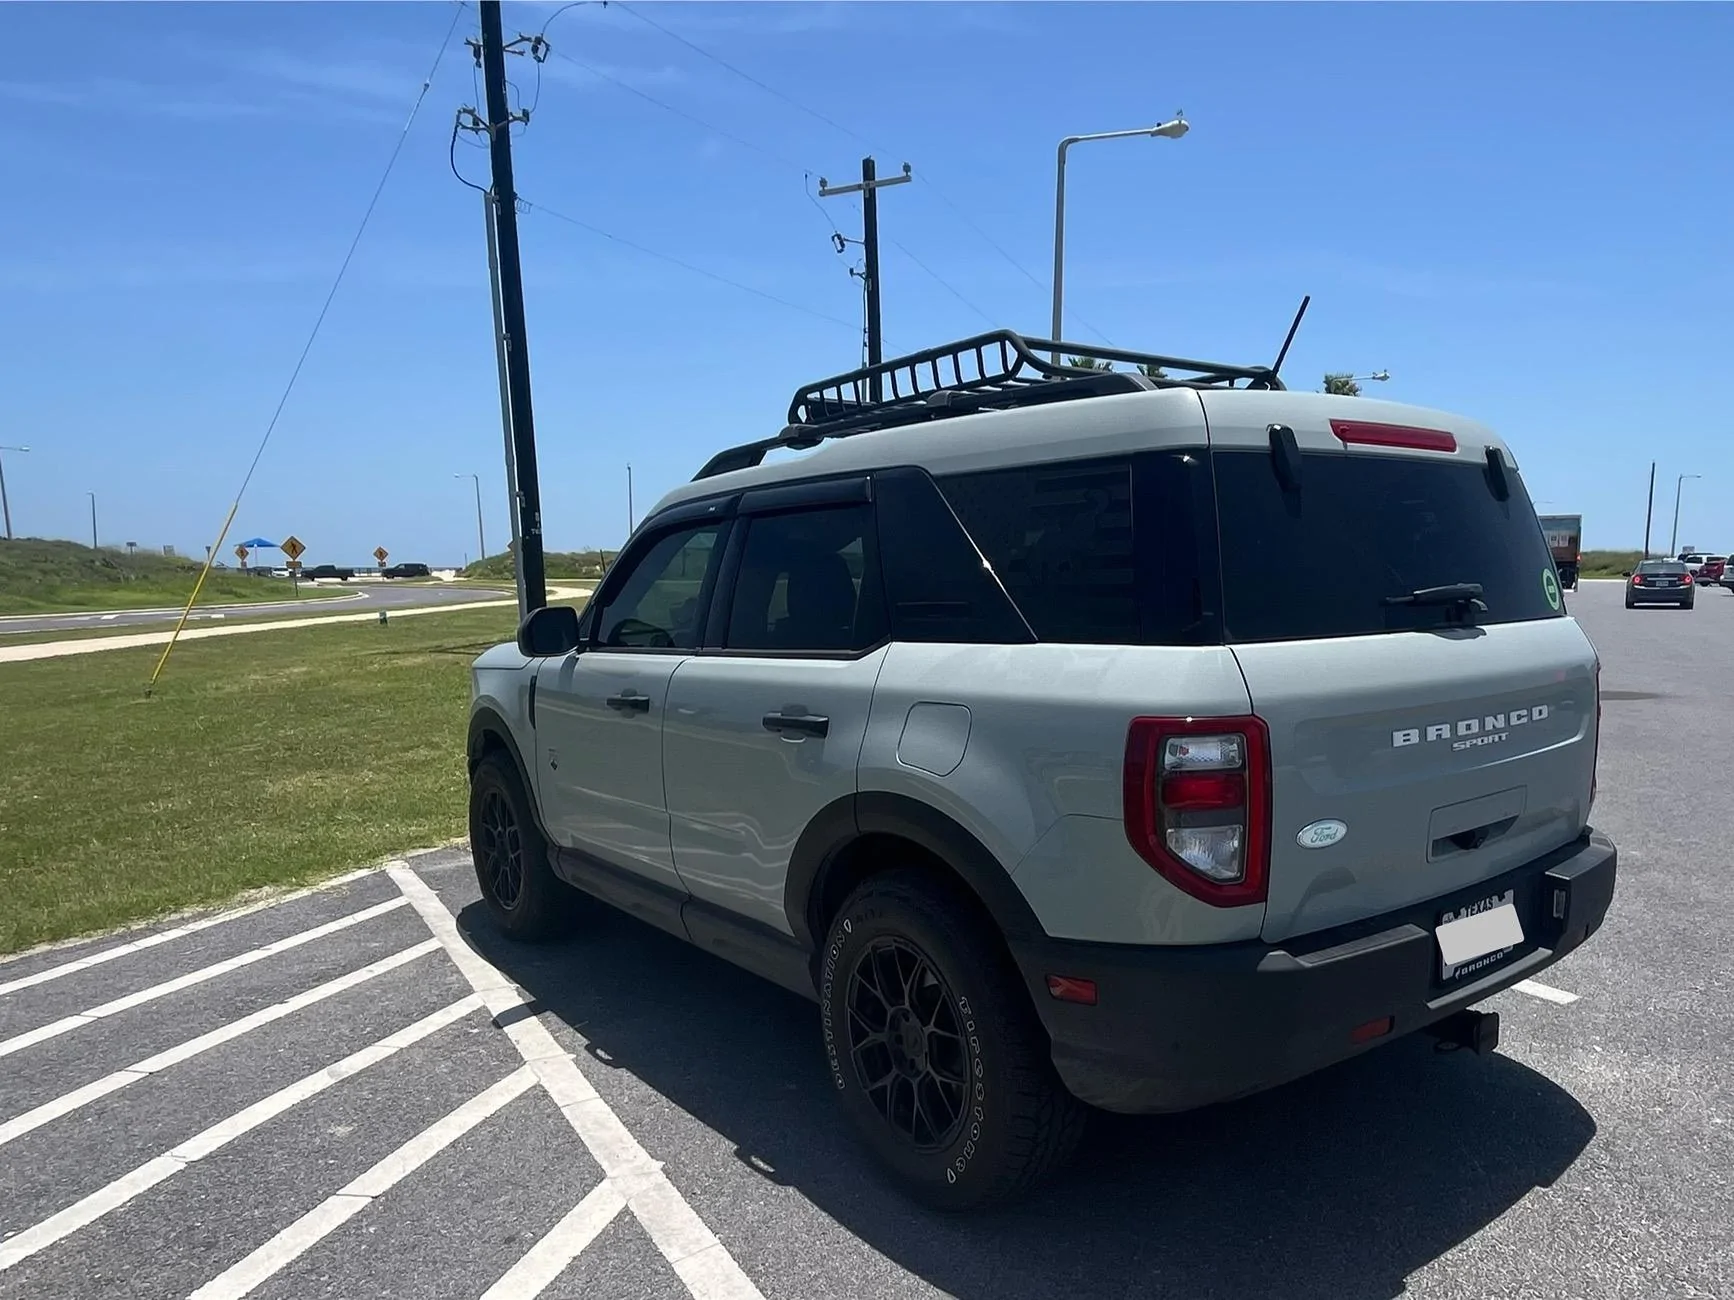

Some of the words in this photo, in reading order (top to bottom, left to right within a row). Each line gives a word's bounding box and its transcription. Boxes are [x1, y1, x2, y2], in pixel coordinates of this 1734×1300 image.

[1392, 704, 1549, 748] BRONCO
[1452, 732, 1509, 751] SPORT
[1310, 826, 1339, 843] Ford
[1461, 951, 1504, 976] BRONCO
[822, 929, 847, 1089] DESTINATION
